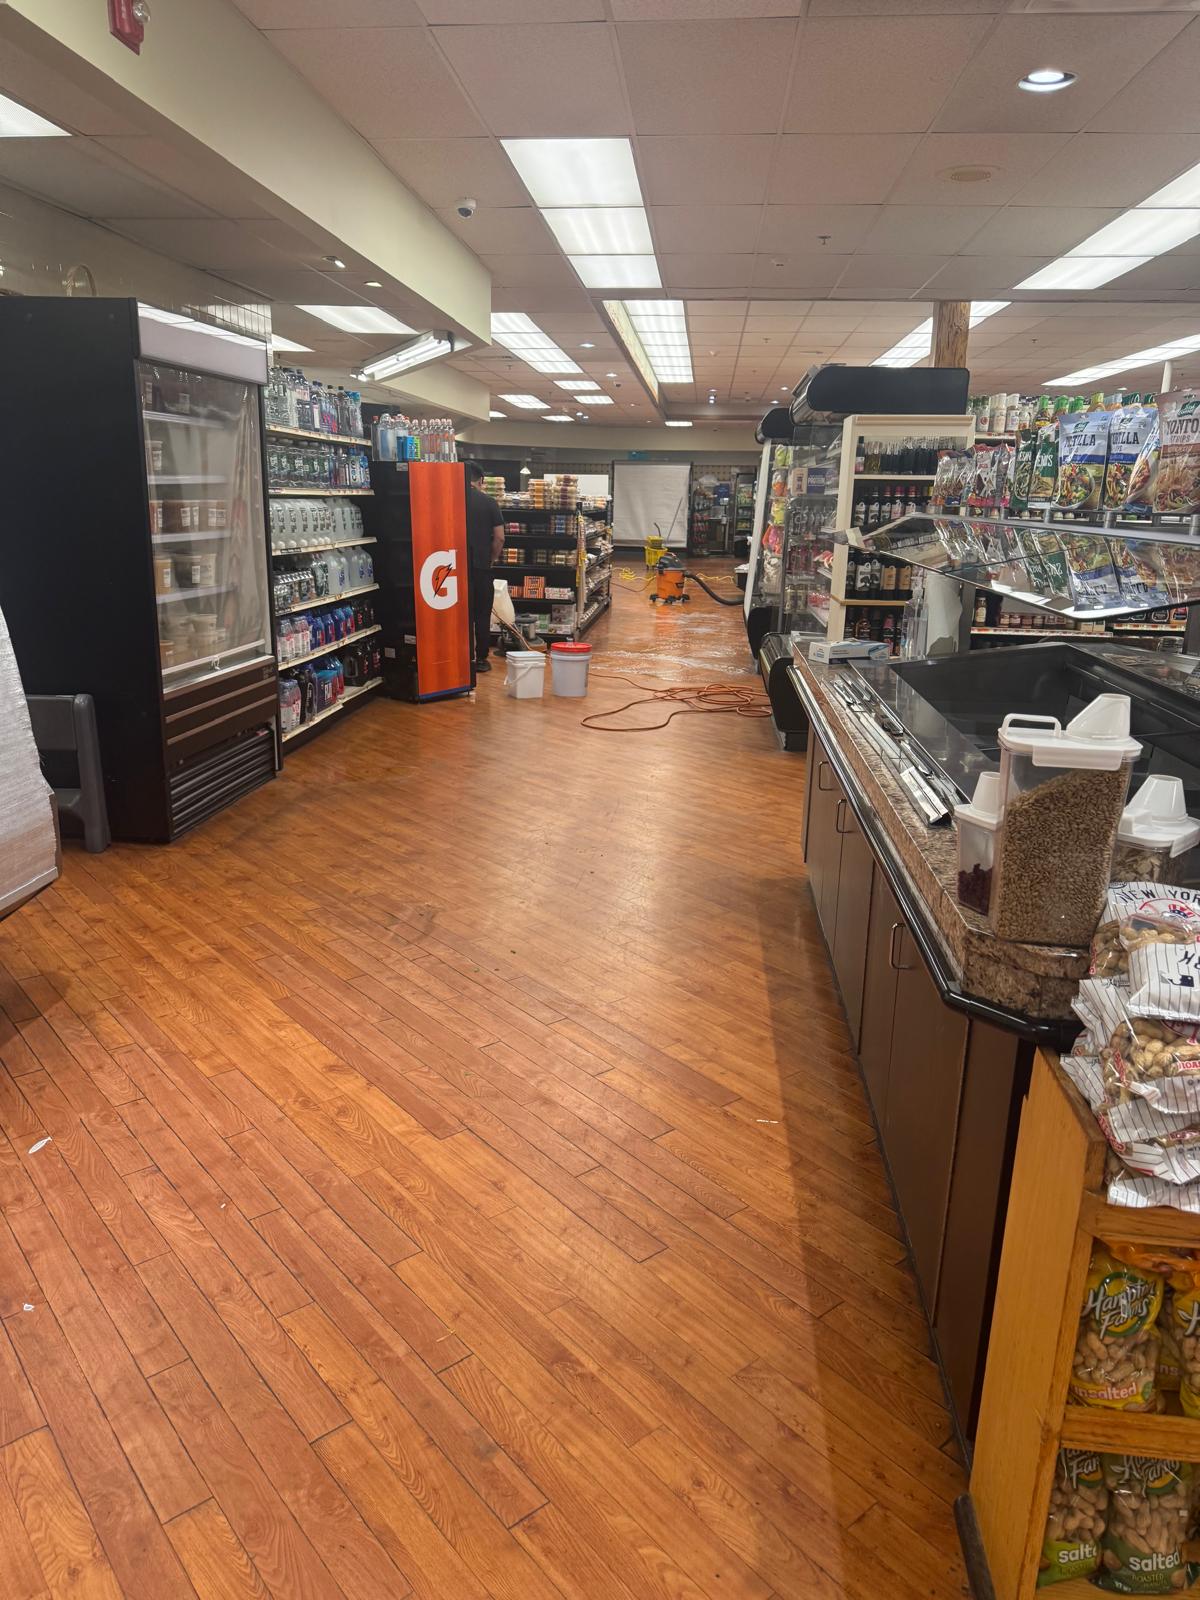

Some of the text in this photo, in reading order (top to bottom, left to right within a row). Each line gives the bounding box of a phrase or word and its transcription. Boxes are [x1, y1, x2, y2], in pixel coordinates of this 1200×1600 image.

[420, 549, 459, 611] G
[1115, 889, 1157, 904] NEW
[1081, 1280, 1157, 1321] Hampton
[1099, 1298, 1149, 1341] Farms
[1129, 1546, 1181, 1572] salted
